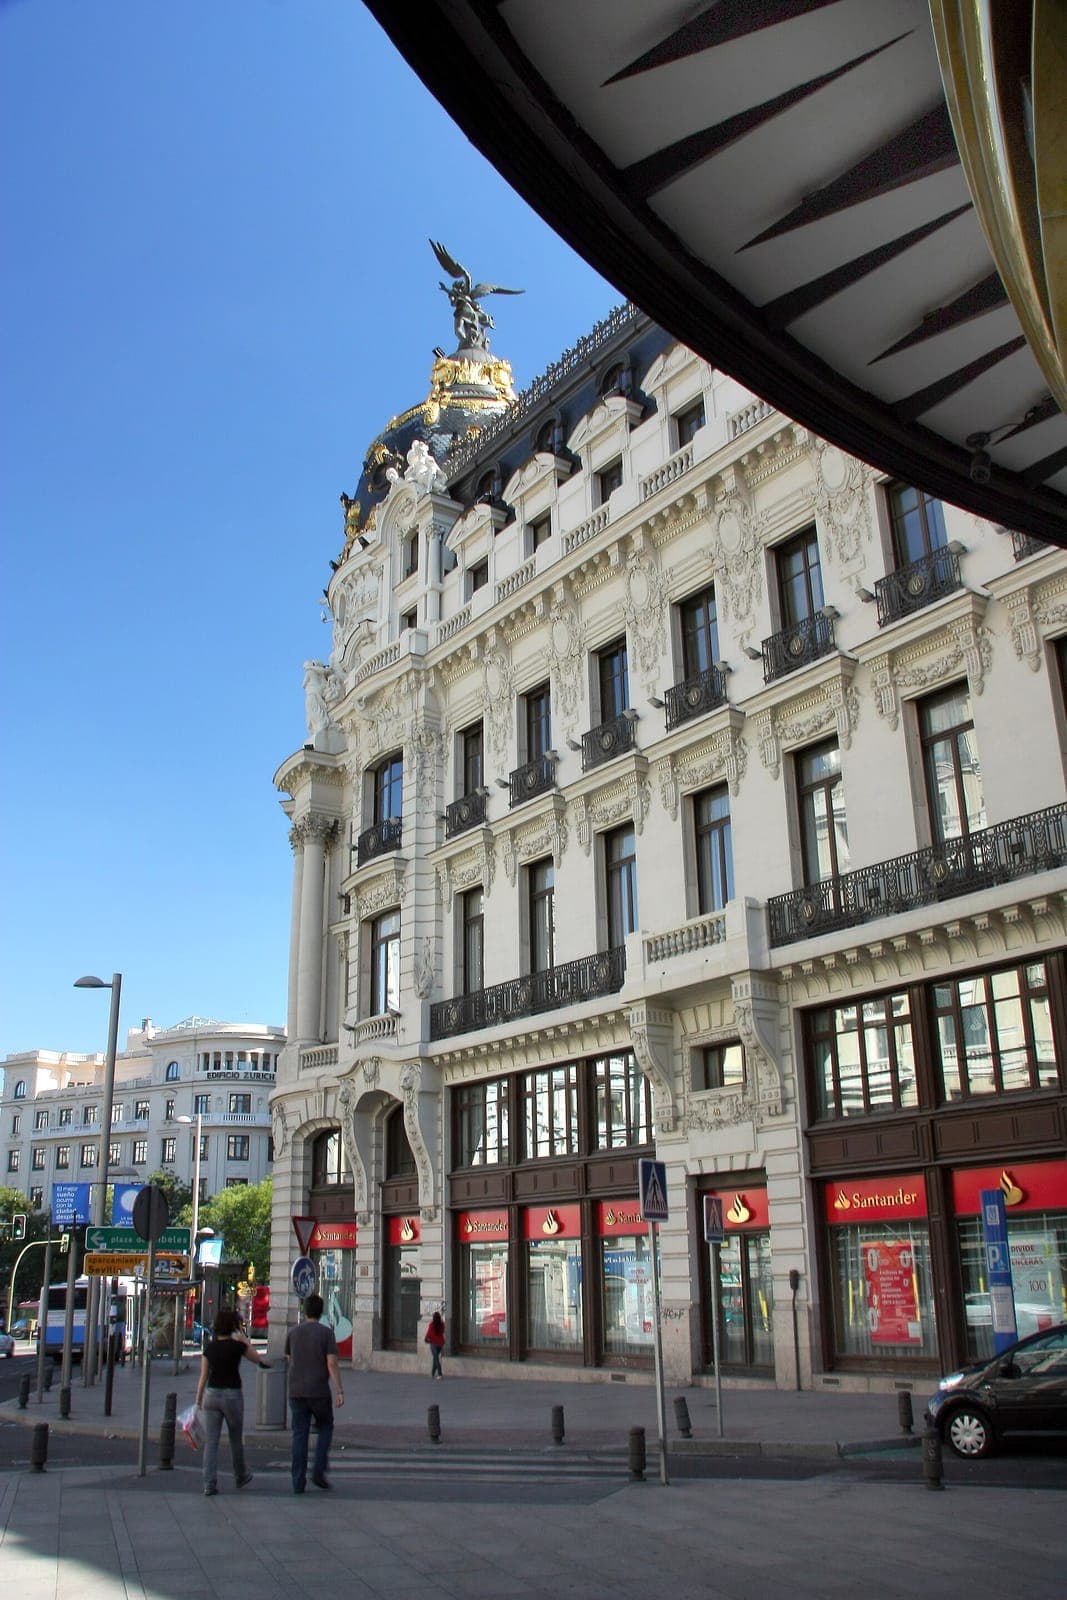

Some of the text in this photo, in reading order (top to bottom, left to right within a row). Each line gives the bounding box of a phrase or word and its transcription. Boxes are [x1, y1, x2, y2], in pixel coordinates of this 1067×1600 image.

[207, 1071, 275, 1080] EDIFICIO ZURICH
[852, 1188, 918, 1209] Santander
[617, 1210, 641, 1225] Santa
[473, 1218, 508, 1233] Santander
[110, 1235, 133, 1244] plaza
[158, 1235, 187, 1244] ibeles
